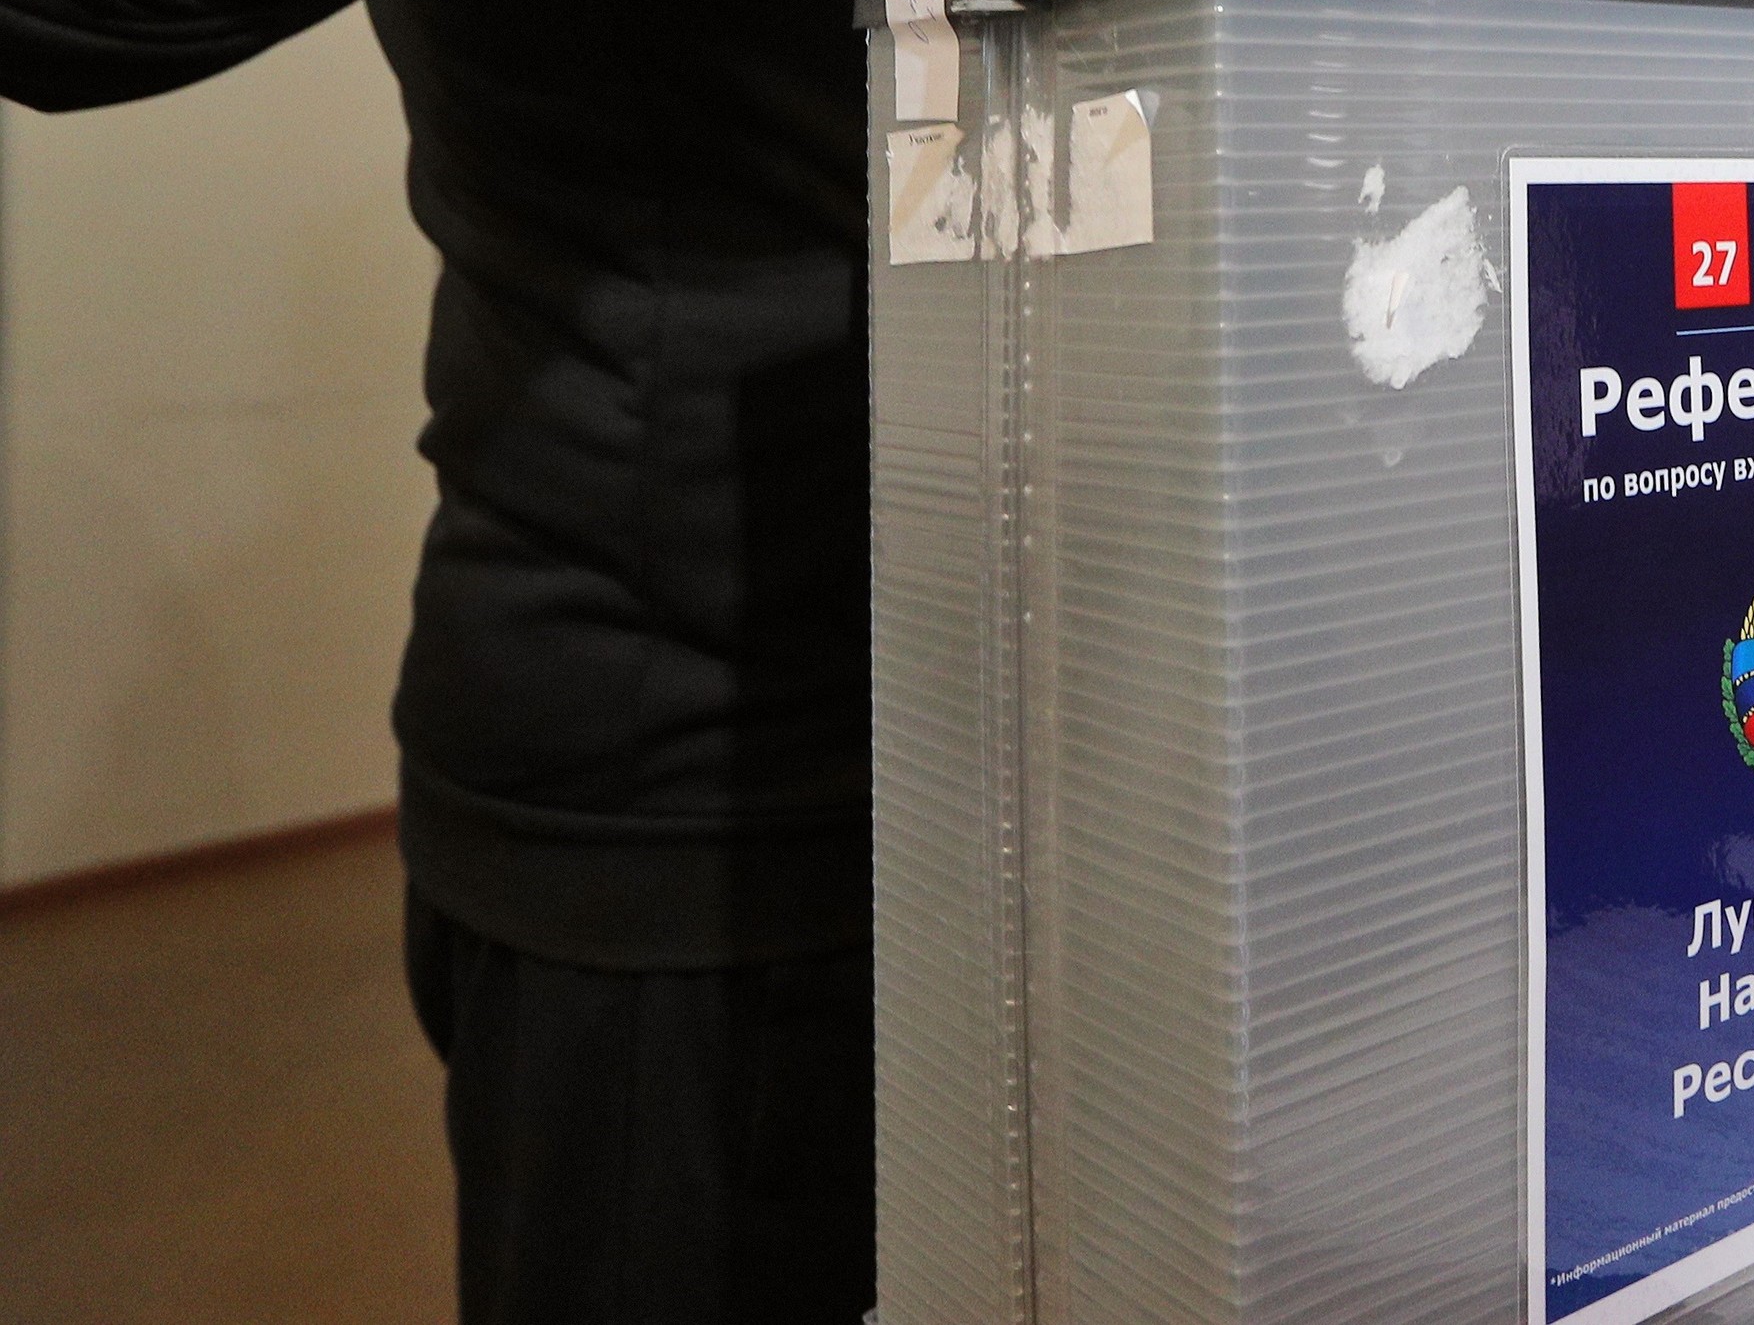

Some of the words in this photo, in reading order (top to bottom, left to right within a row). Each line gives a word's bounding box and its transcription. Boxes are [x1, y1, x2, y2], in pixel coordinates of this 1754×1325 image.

[1691, 241, 1738, 286] 27
[1583, 476, 1616, 502] по
[1624, 461, 1725, 498] вопросу
[1663, 1203, 1715, 1236] материал
